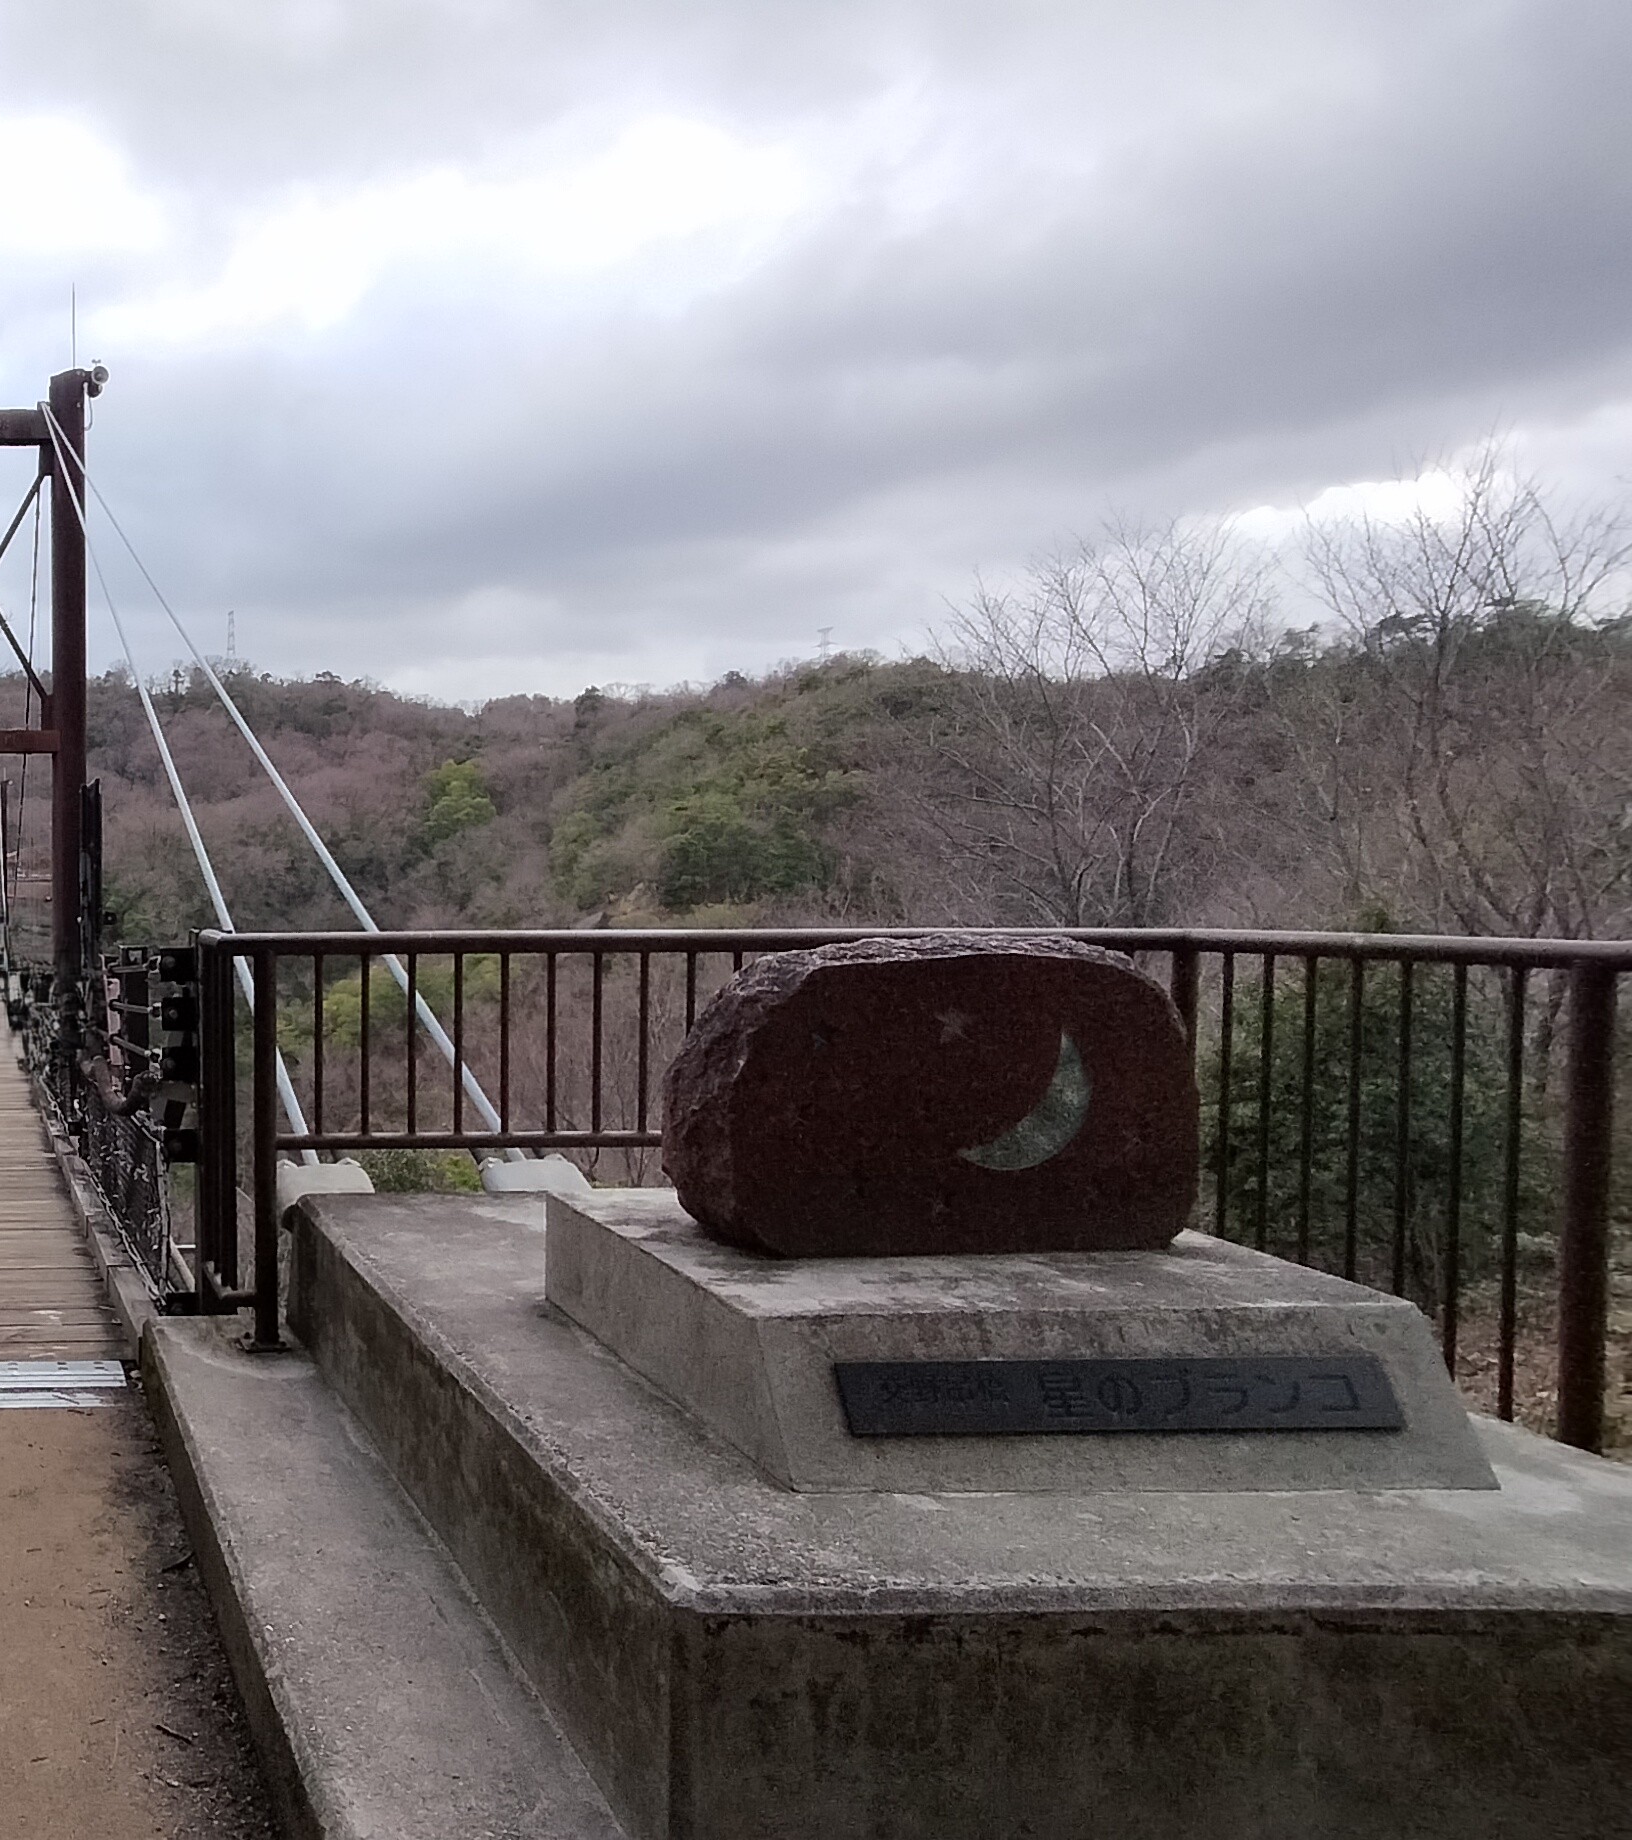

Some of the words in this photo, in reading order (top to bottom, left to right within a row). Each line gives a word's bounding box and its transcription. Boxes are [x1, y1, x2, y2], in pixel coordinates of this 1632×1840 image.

[1039, 1368, 1362, 1420] 星のブランコ
